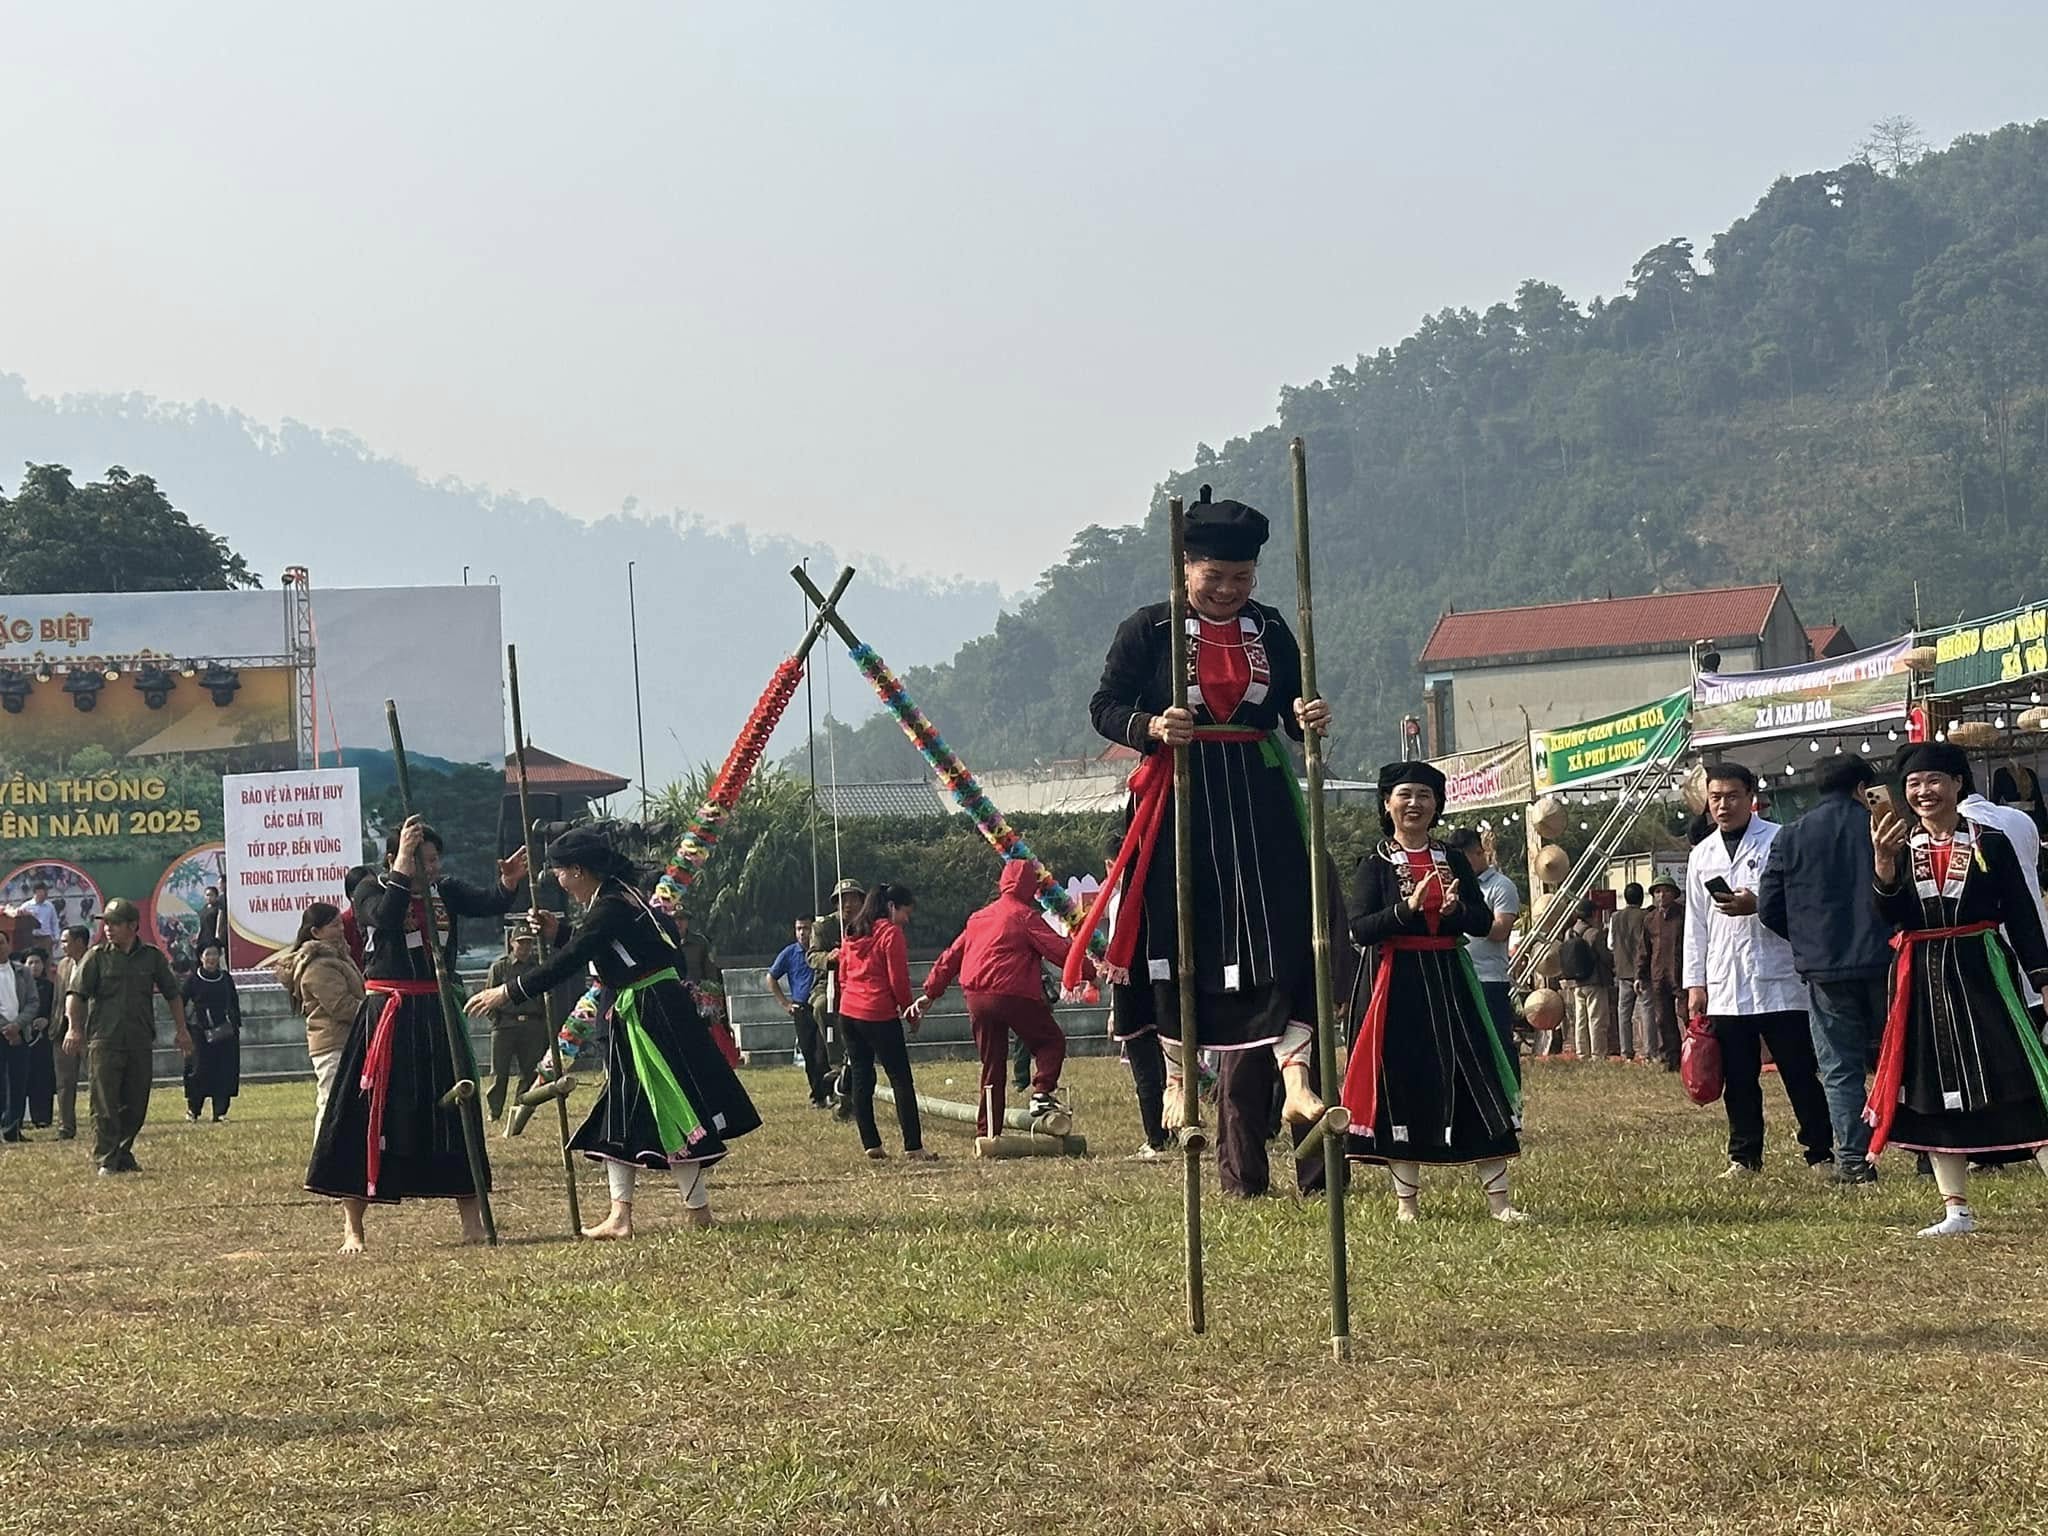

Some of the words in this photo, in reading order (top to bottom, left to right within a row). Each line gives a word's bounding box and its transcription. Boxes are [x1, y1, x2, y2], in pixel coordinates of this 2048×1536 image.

[40, 612, 93, 648] BIỆT
[1936, 629, 1980, 664] KHÔNG
[1983, 620, 2015, 652] GIAN
[1704, 683, 1744, 705] KHÔNG
[1857, 656, 1895, 681] THỰC
[1755, 704, 1774, 728] XÃ
[1775, 702, 1803, 726] NAM
[1805, 696, 1832, 721] HÒA
[1550, 730, 1587, 752] KHÔNG
[1588, 722, 1614, 742] GIAN
[1615, 714, 1638, 735] VĂN
[1638, 707, 1665, 730] HÓA
[1567, 748, 1584, 772] XÃ
[1584, 744, 1607, 768] PHÚ
[57, 769, 166, 802] THỐNG
[241, 786, 262, 804] BẢO
[264, 785, 277, 806] VỆ
[280, 784, 292, 802] VÀ
[295, 782, 320, 801] PHÁT
[323, 784, 343, 799] HUY
[0, 809, 38, 839] ÊN
[50, 808, 119, 837] NĂM
[130, 809, 201, 835] 2025
[264, 810, 284, 829] CÁC
[287, 808, 304, 827] GIÁ
[306, 811, 323, 829] TRỊ
[248, 838, 265, 857] TỐT
[268, 842, 289, 859] ĐẸP,
[314, 835, 341, 854] VỮNG
[240, 870, 273, 886] TRONG
[249, 894, 269, 913] VĂN
[271, 892, 292, 912] HÓA
